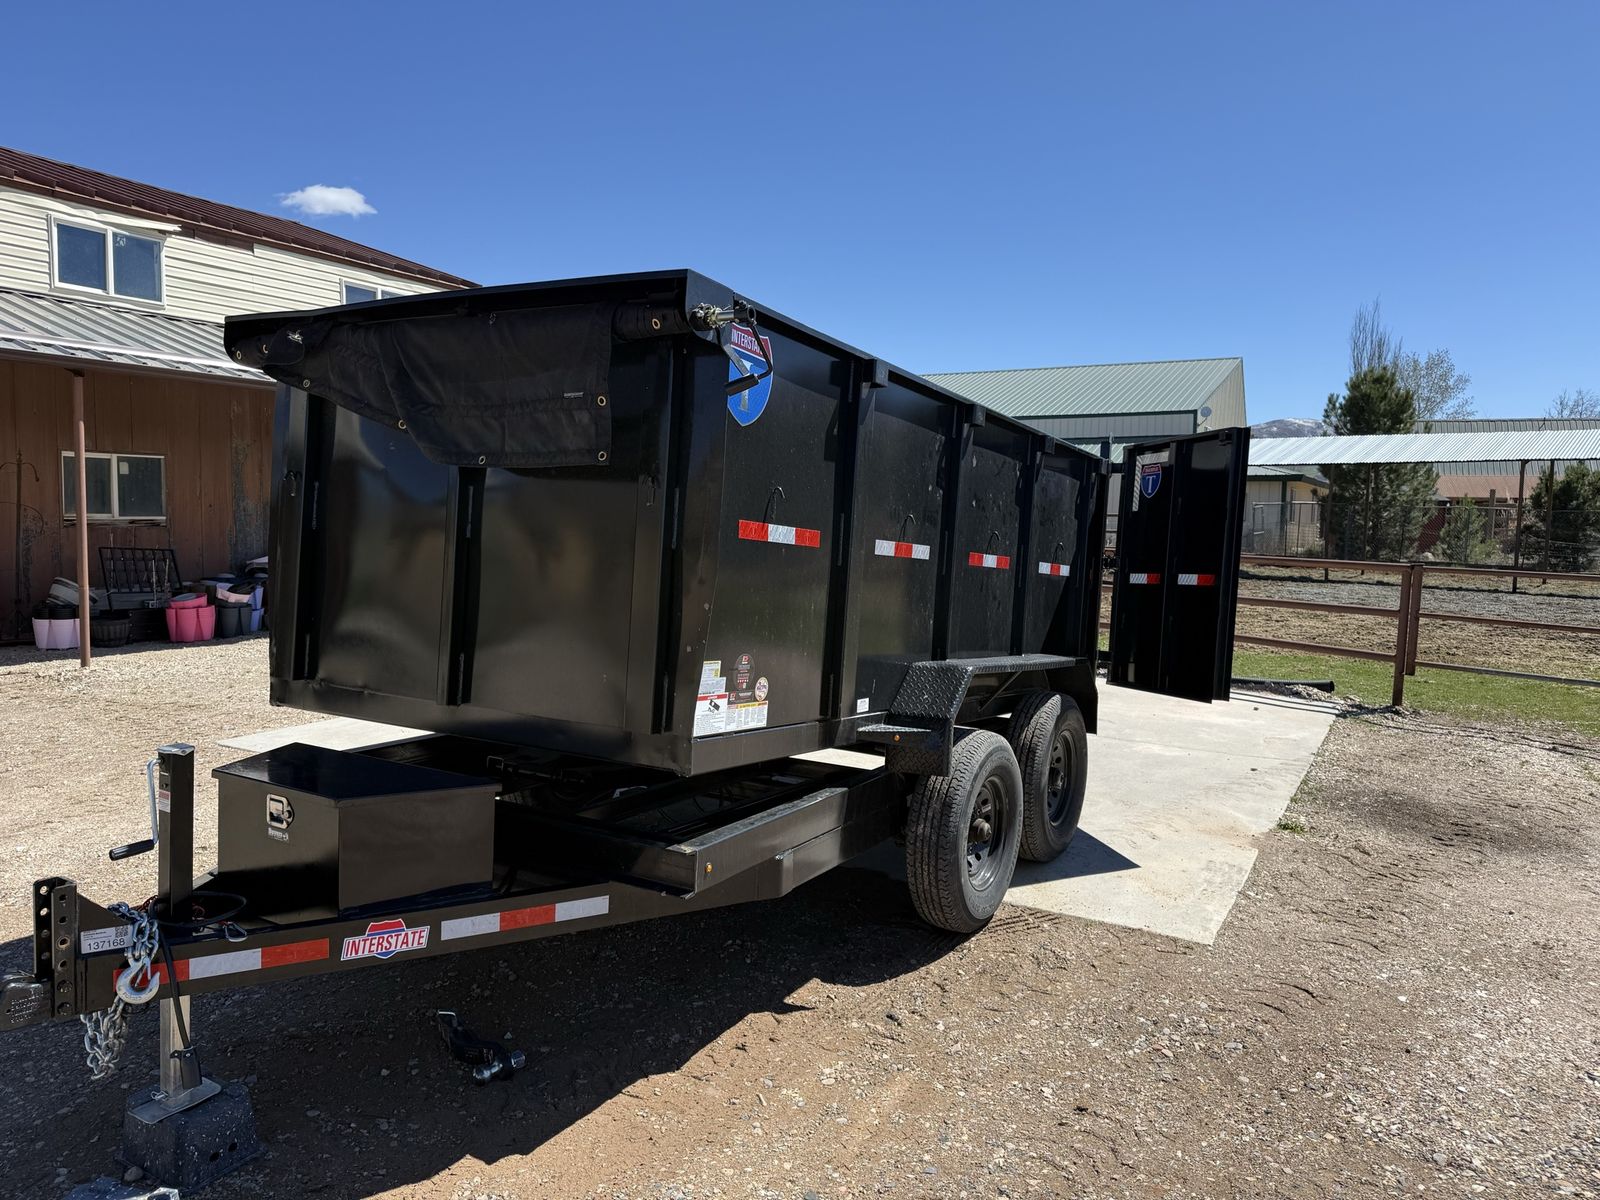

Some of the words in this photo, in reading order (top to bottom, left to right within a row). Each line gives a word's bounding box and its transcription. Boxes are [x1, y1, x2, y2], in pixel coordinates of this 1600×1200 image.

[731, 328, 763, 355] INTERSTA
[88, 937, 126, 951] 137168
[345, 929, 426, 957] INTERSTATE
